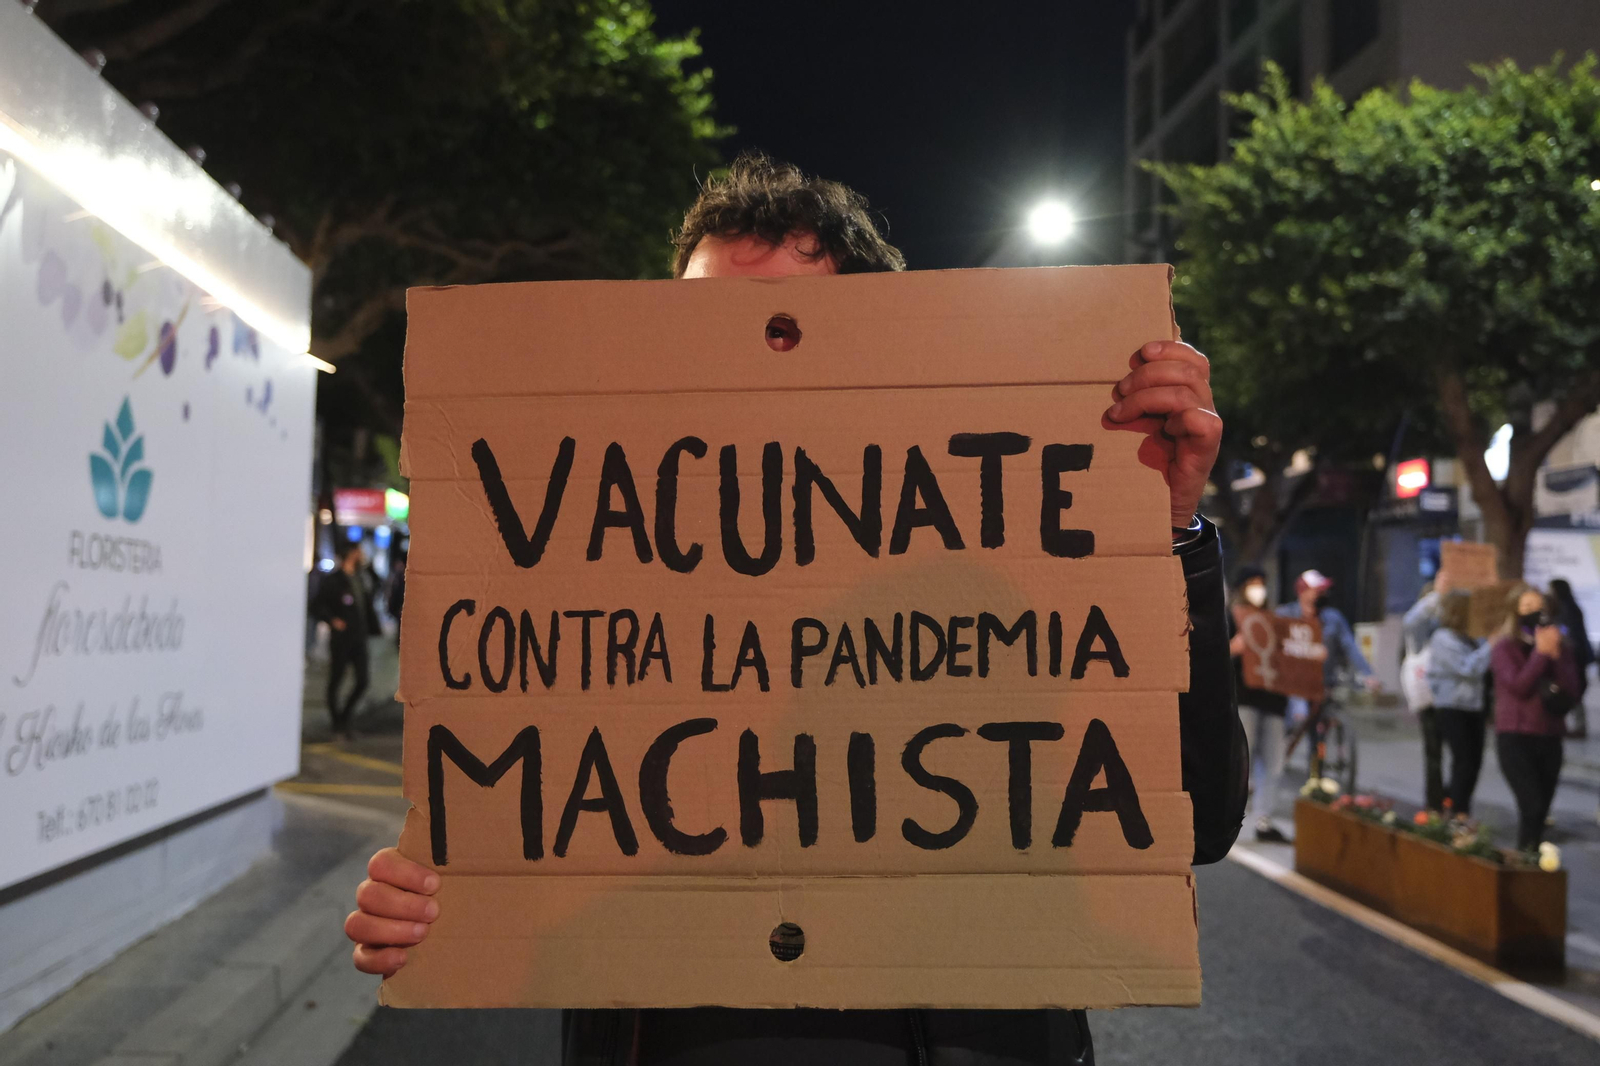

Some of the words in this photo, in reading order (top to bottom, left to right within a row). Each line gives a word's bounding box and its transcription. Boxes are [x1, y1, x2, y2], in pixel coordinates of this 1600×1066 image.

[471, 432, 1095, 577] VACUNATE
[438, 599, 673, 693] CONTRA
[701, 613, 770, 693] LA
[790, 605, 1131, 689] PANDEMIA
[426, 718, 1155, 867] MACHISTA
